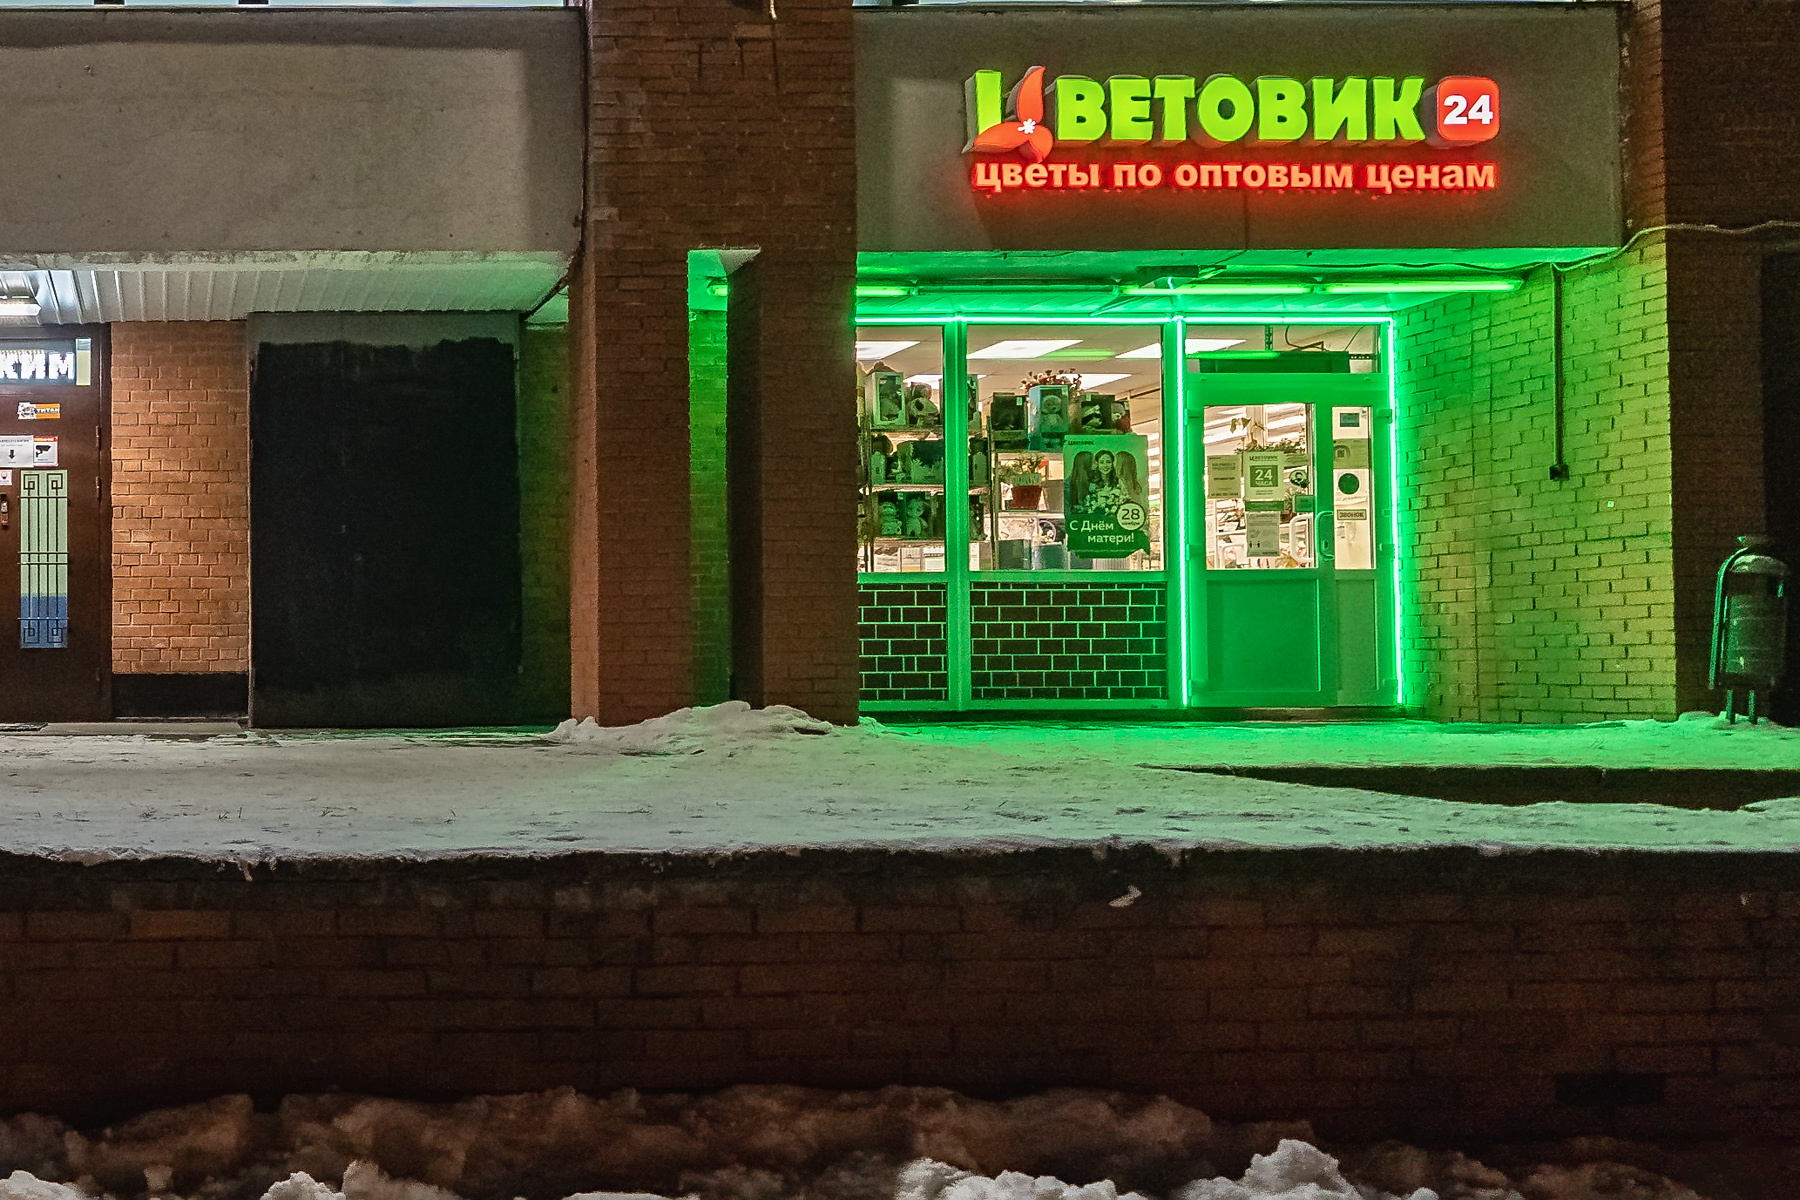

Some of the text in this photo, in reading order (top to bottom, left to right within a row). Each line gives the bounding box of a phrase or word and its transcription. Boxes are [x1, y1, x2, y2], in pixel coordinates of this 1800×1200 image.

[1442, 94, 1494, 126] 24
[974, 161, 1496, 193] цветы по оптовым ценам
[1255, 469, 1273, 481] 24
[1121, 508, 1140, 520] 28
[1069, 520, 1114, 532] С Днём
[1087, 533, 1135, 546] матери!
